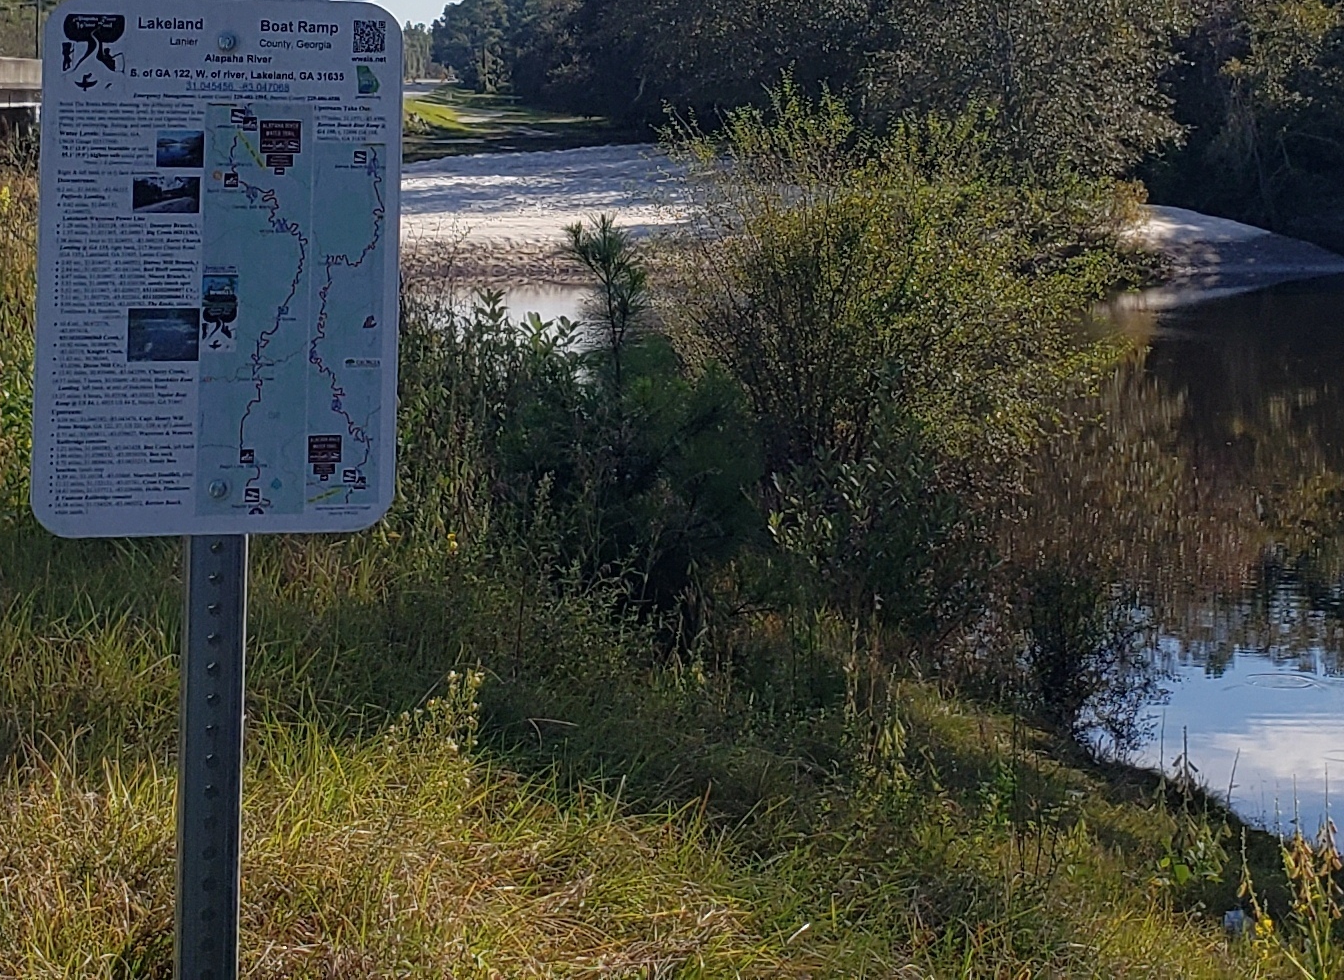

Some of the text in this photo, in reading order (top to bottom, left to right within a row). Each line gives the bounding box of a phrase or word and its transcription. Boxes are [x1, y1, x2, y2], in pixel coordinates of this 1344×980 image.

[138, 17, 339, 36] Lakeland Boat Ramp
[169, 37, 332, 51] Lanier County, Georgia
[204, 54, 272, 64] Alapaha River
[143, 69, 153, 77] of
[156, 70, 171, 78] GA
[174, 70, 193, 79] 122,
[196, 70, 208, 78] W.
[211, 70, 221, 78] of
[223, 71, 248, 81] river,
[250, 72, 297, 81] Lakeland,
[299, 72, 314, 80] GA
[316, 73, 345, 81] 31635
